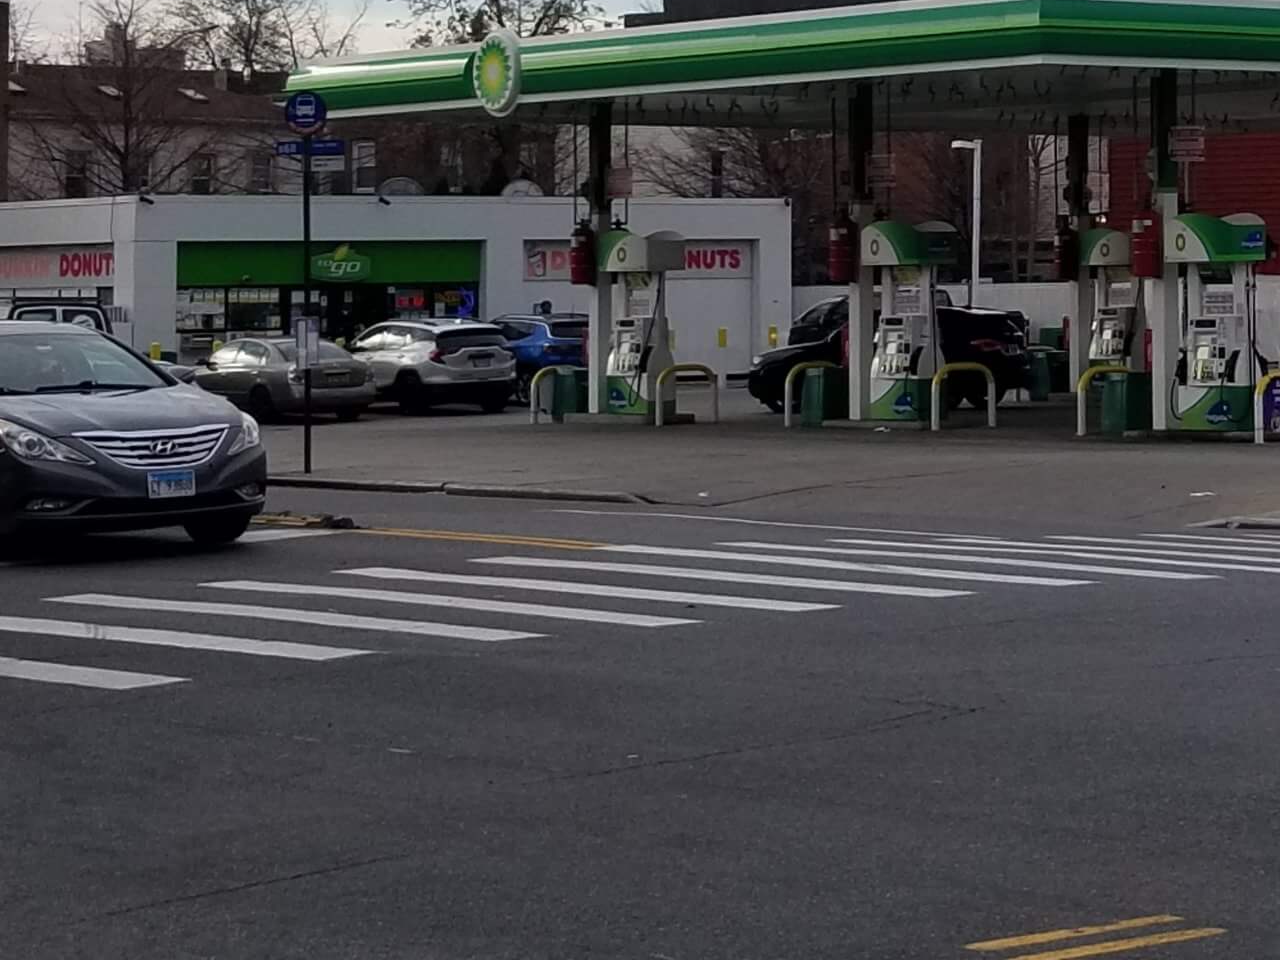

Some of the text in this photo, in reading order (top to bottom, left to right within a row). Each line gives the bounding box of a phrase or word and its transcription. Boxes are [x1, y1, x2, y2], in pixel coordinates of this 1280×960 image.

[60, 253, 114, 277] DONUT
[331, 260, 361, 277] go
[684, 249, 742, 270] NUTS
